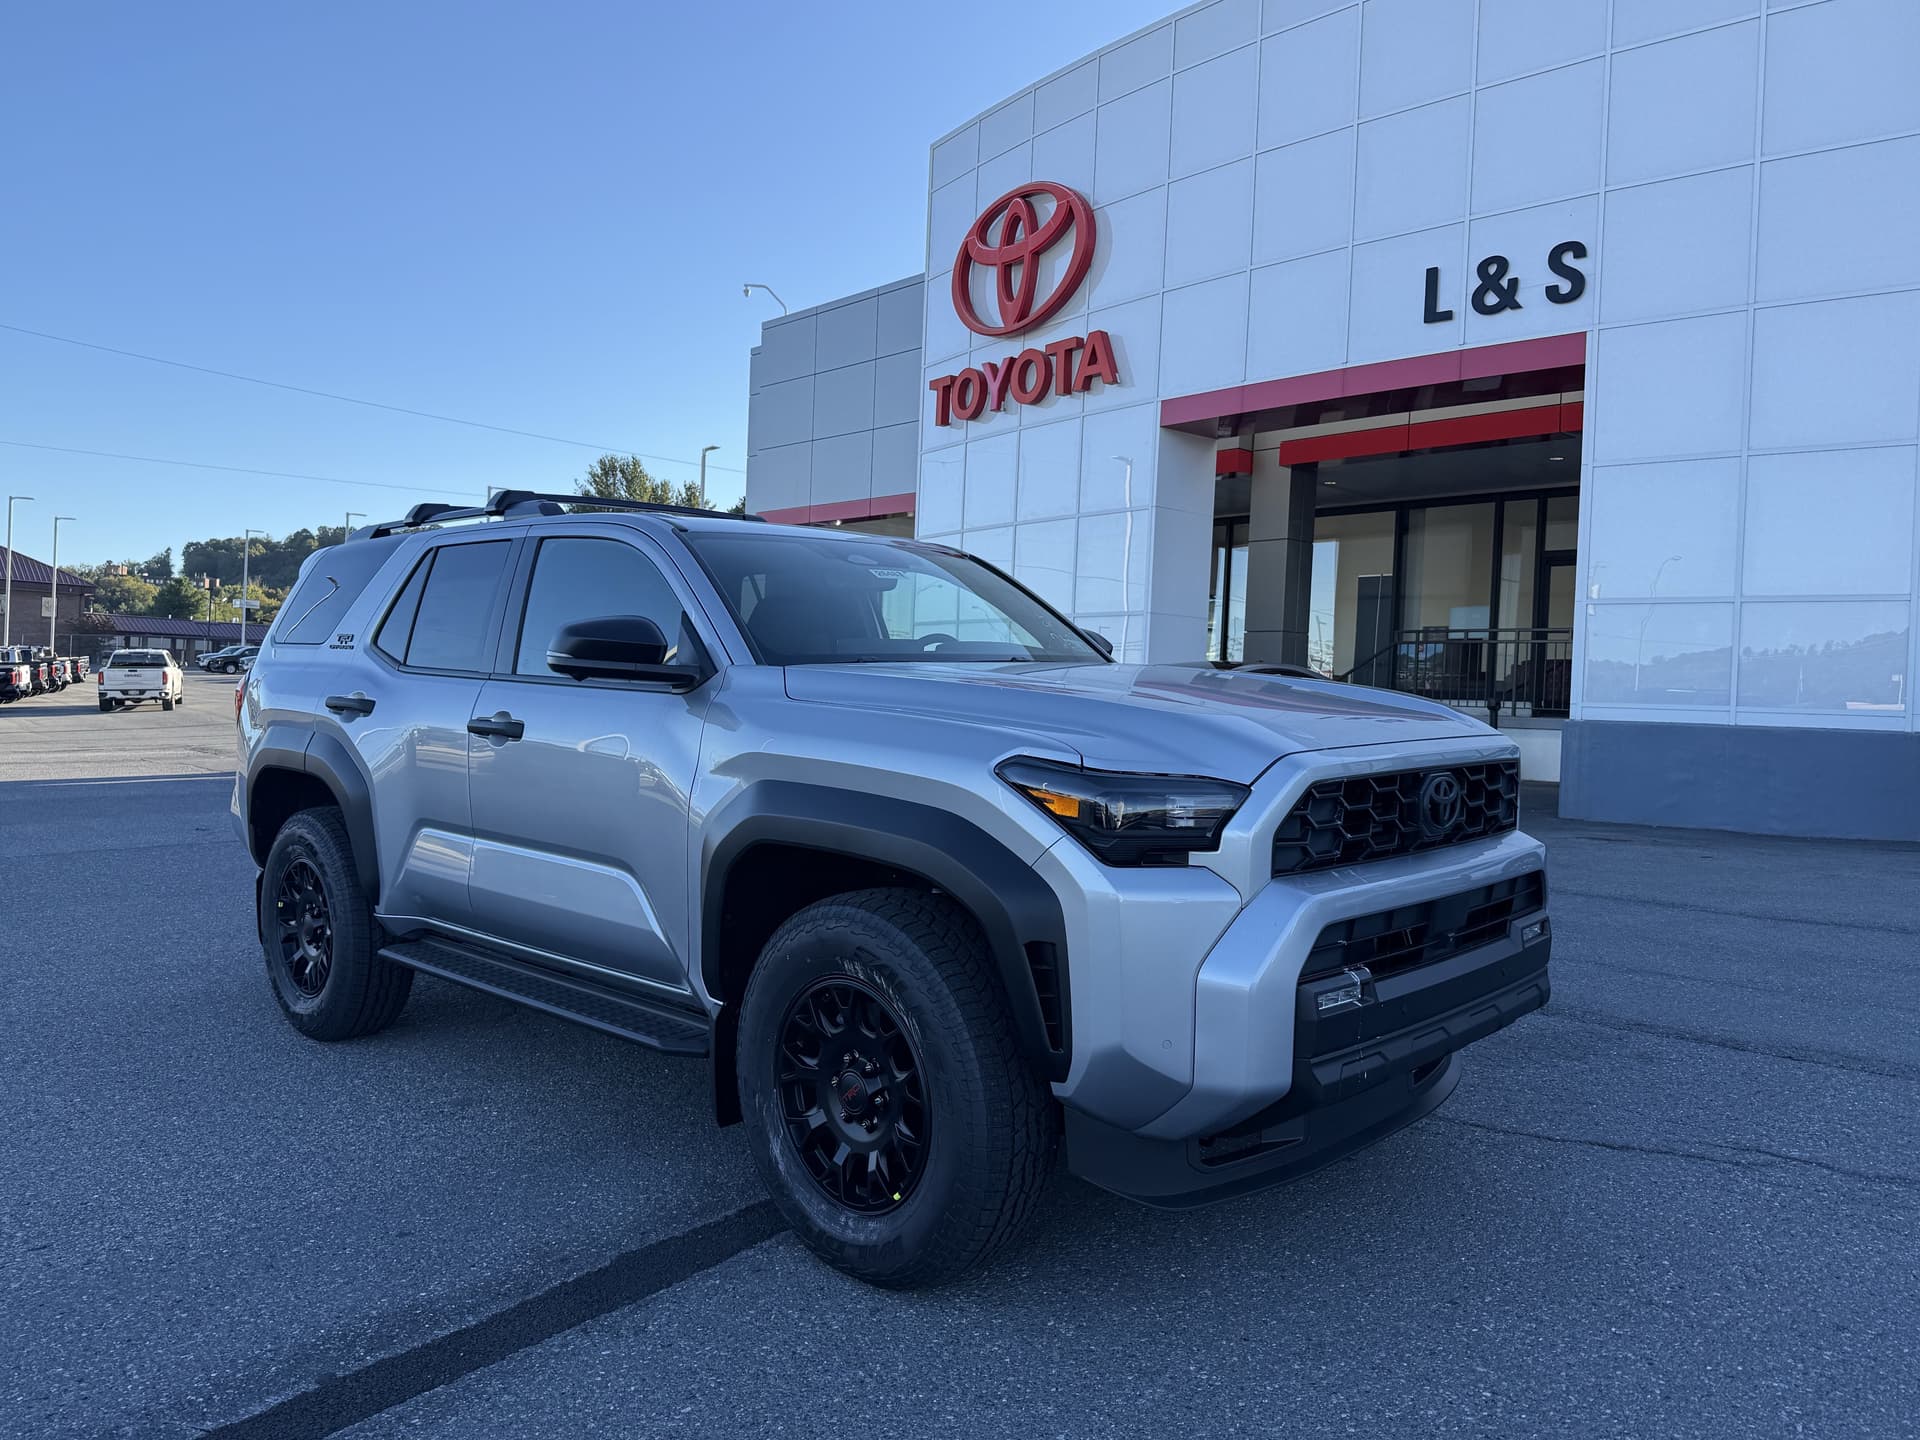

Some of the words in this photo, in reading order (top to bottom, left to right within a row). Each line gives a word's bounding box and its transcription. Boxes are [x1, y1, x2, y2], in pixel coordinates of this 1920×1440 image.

[1424, 267, 1453, 324] L
[1471, 255, 1523, 316] &
[1545, 241, 1588, 304] S
[929, 330, 1120, 427] TOYOTA
